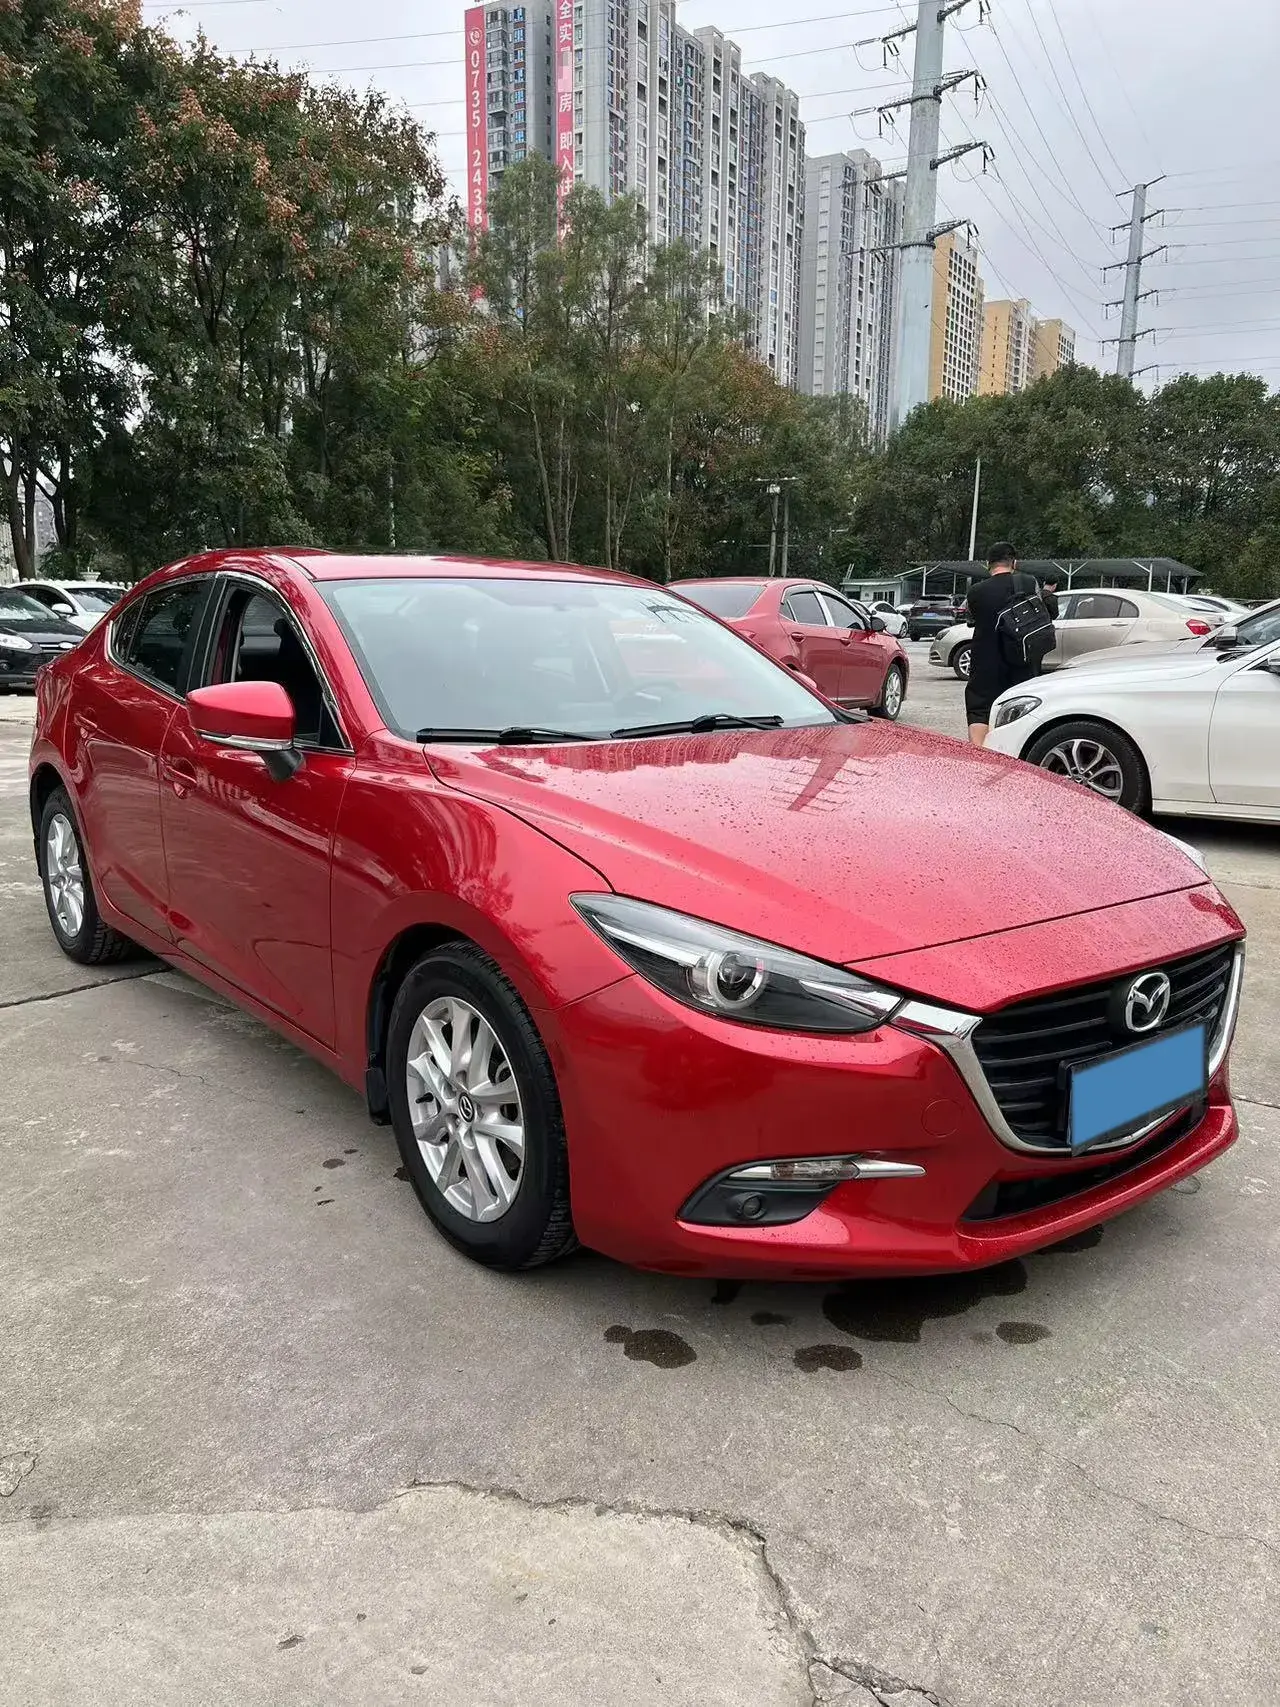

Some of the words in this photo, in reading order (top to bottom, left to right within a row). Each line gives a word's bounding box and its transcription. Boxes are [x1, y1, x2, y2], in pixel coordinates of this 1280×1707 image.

[559, 0, 573, 113] 全实房
[470, 50, 484, 252] 0735-2438
